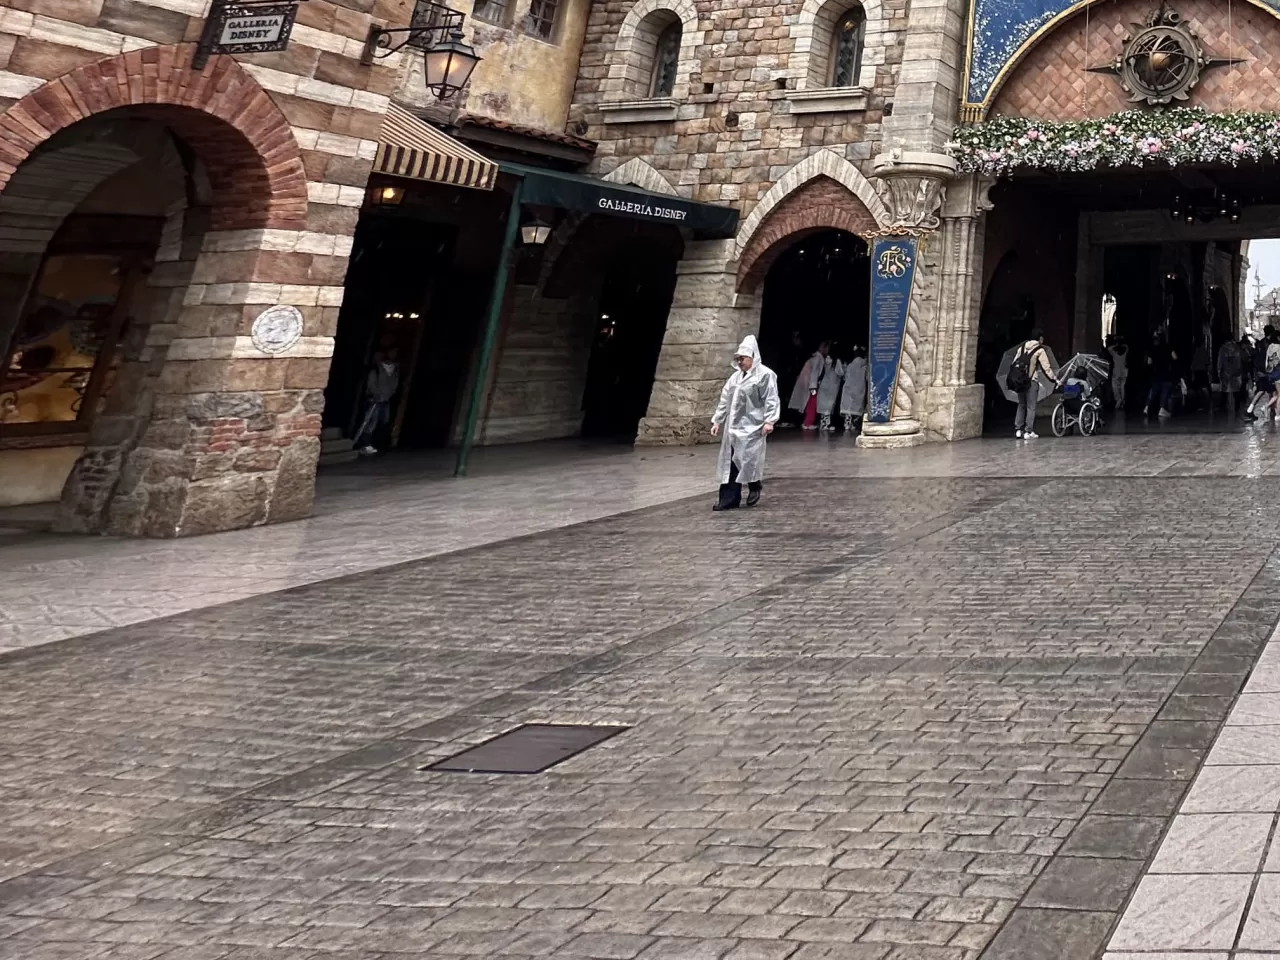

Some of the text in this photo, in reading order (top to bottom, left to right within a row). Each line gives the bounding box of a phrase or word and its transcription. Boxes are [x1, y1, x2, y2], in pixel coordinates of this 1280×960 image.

[228, 19, 279, 29] GALLERIA
[230, 29, 272, 40] DISNEY
[598, 198, 687, 221] GALLERIA DISNEY
